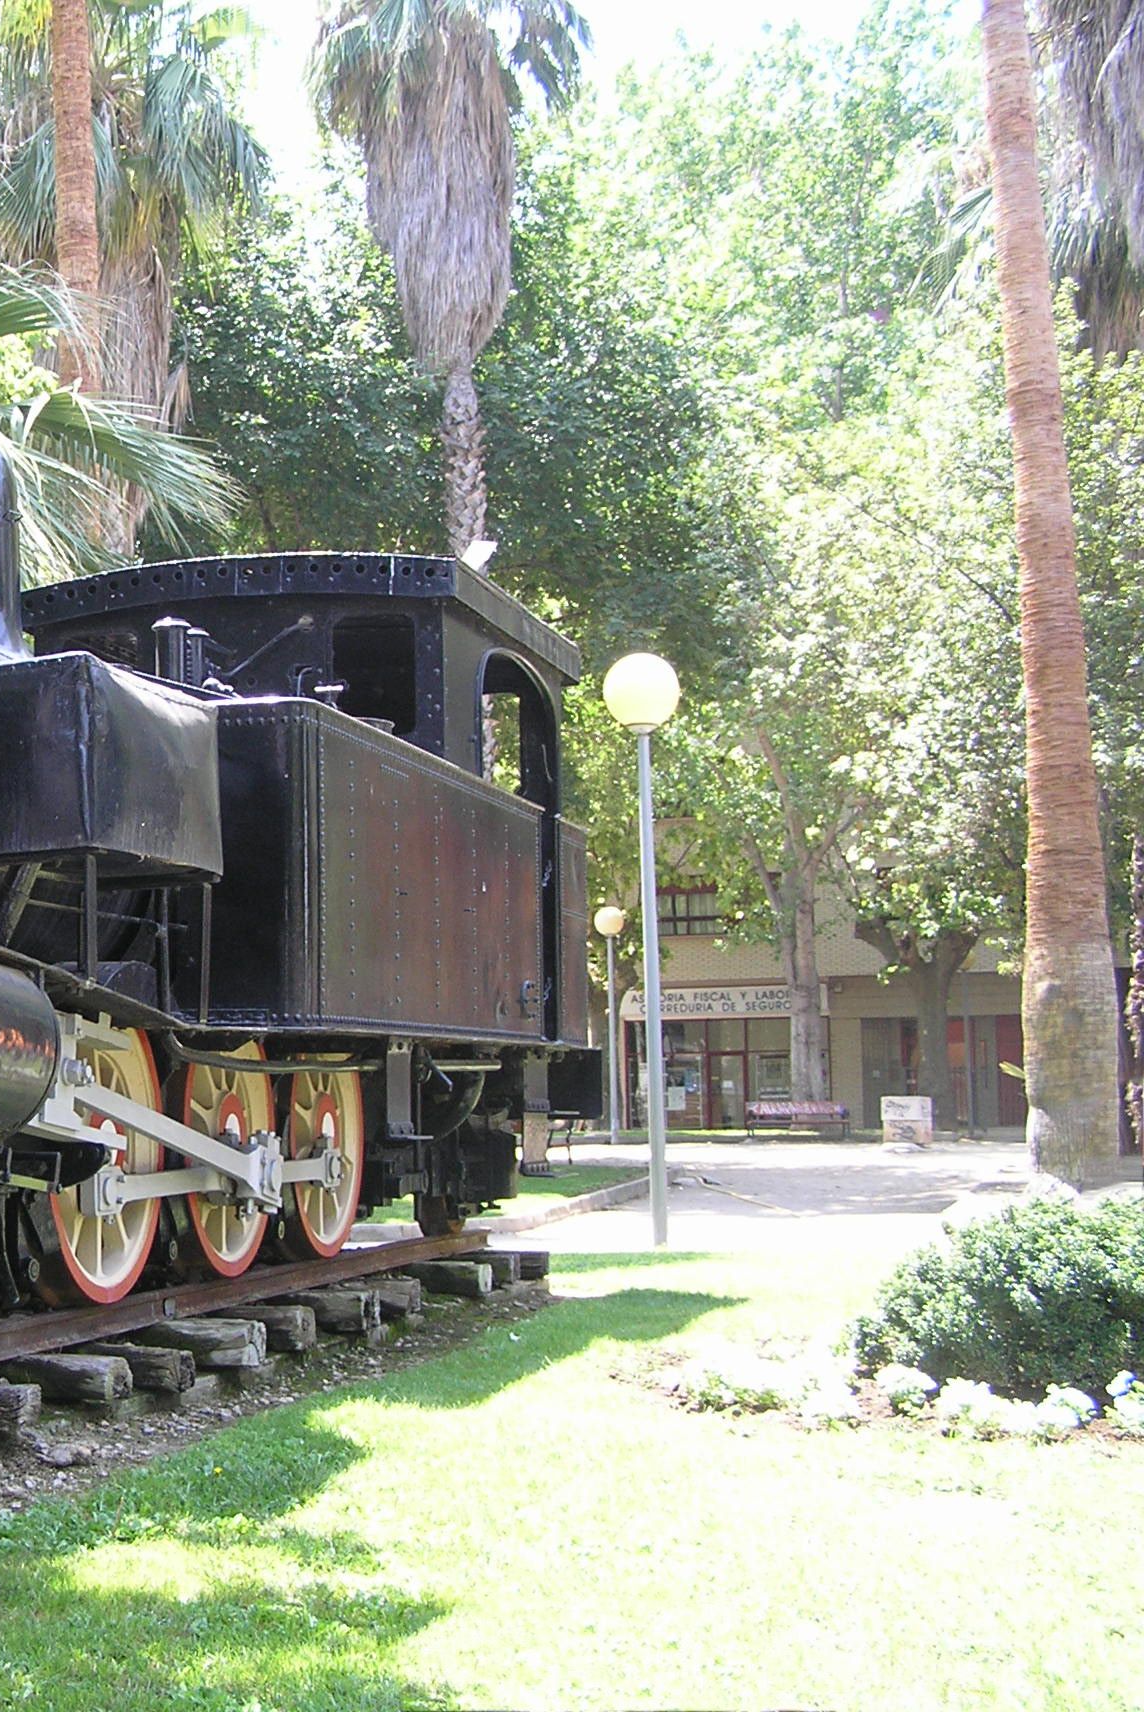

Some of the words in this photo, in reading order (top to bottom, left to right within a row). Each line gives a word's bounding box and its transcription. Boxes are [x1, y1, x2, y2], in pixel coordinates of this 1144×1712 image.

[693, 990, 732, 1002] FISCAL
[740, 991, 747, 1001] Y
[639, 1002, 714, 1014] CRREDURIA
[722, 1002, 736, 1012] DE
